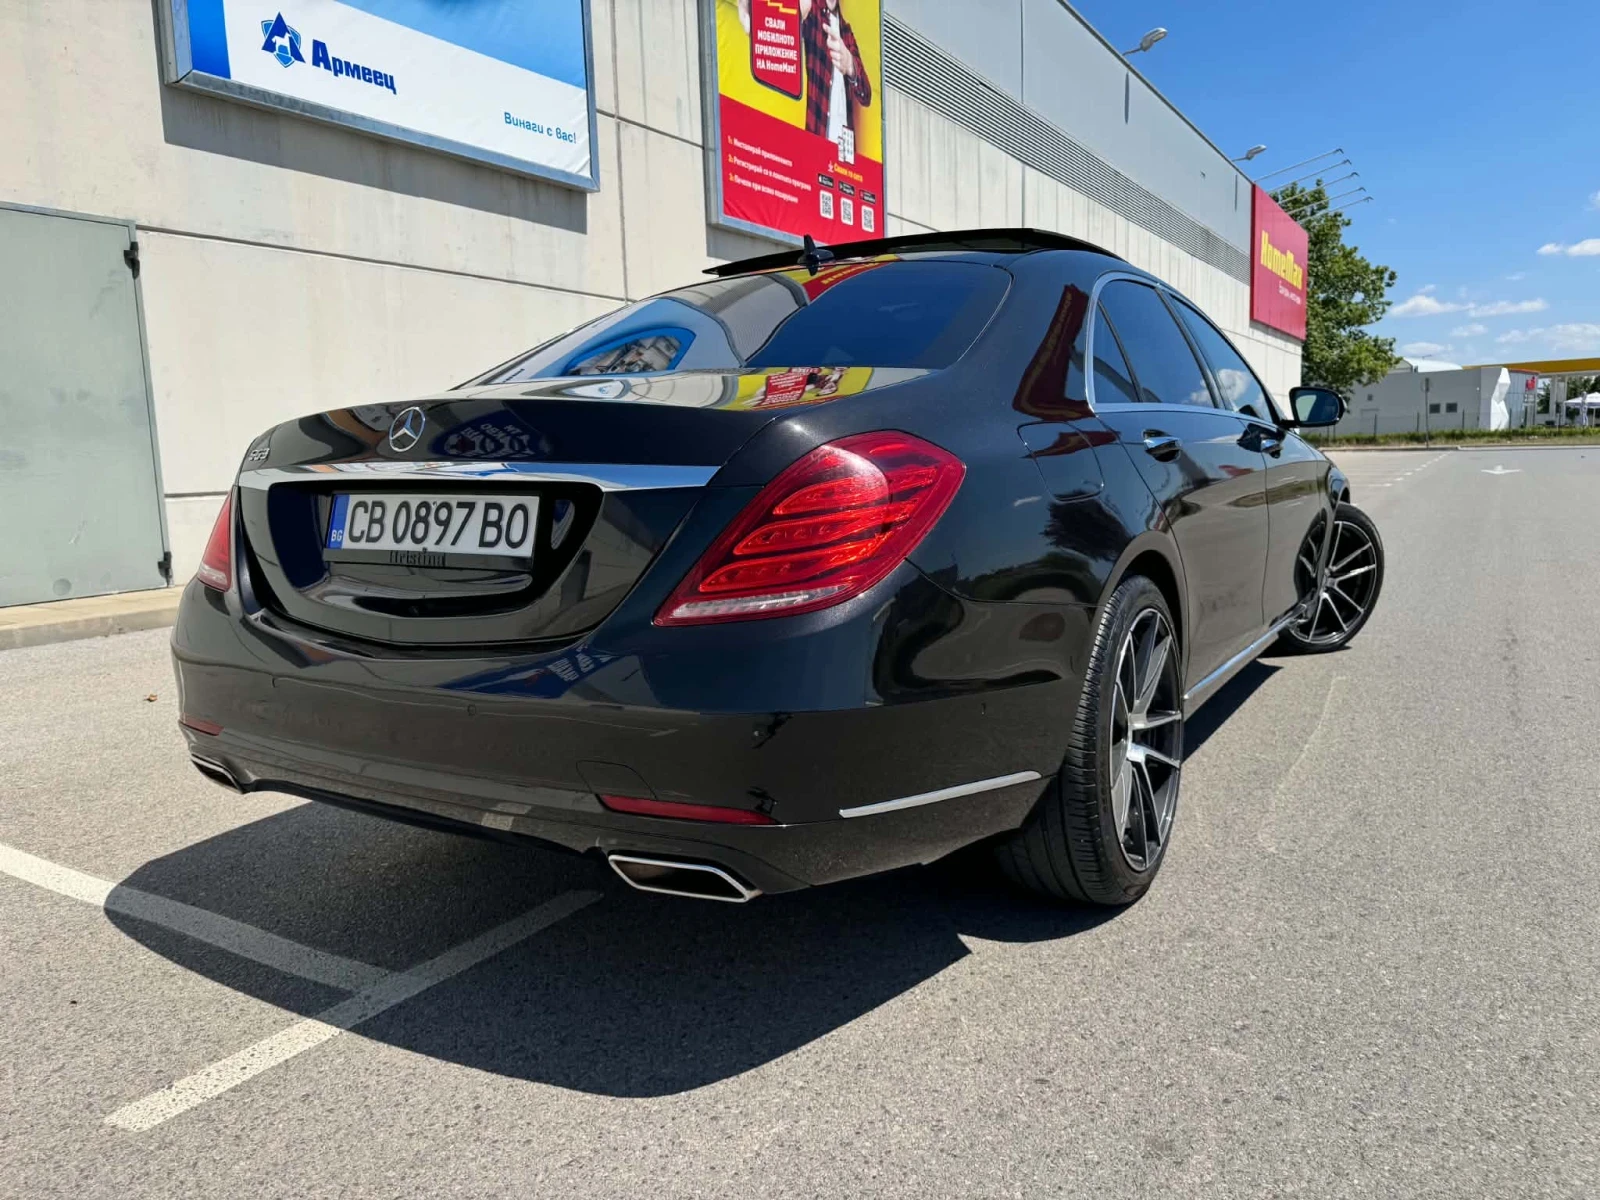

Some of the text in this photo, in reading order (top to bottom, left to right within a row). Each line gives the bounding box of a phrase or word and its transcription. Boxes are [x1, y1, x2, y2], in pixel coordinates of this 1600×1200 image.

[765, 17, 786, 31] СВАЛИ
[757, 30, 795, 46] МОБИЛНОТО
[755, 44, 797, 60] ПРИЛОЖЕНИЕ
[311, 39, 397, 95] Армеец
[504, 112, 577, 145] Винаги с вас!
[350, 501, 386, 543] CB
[392, 501, 476, 547] 0897
[331, 529, 343, 542] BG
